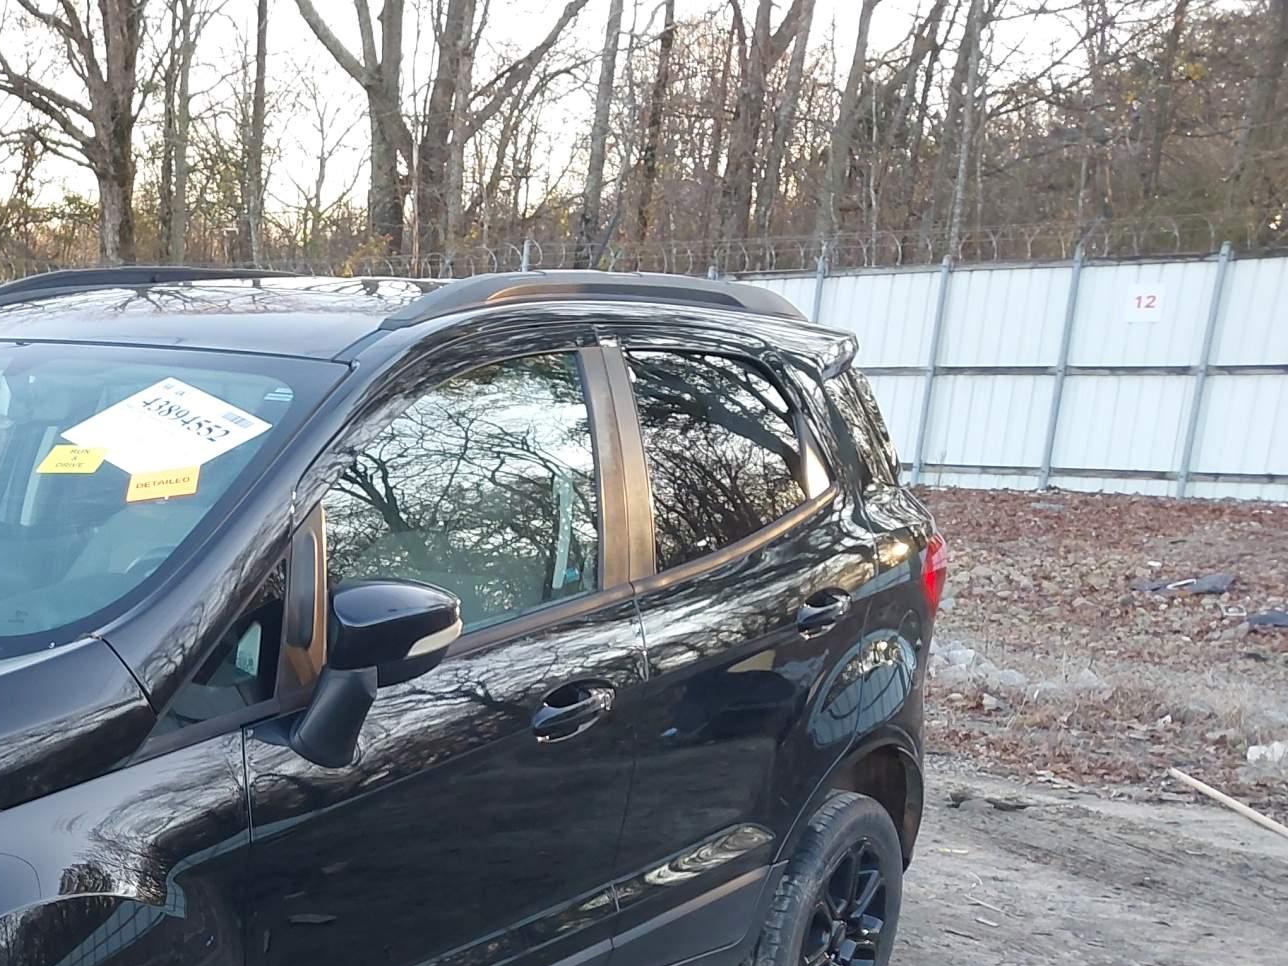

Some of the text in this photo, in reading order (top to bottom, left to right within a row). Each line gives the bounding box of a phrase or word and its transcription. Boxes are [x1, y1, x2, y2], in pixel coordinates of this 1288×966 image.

[1135, 295, 1157, 309] 12
[141, 397, 231, 442] 43894552
[135, 476, 191, 489] DETAILED
